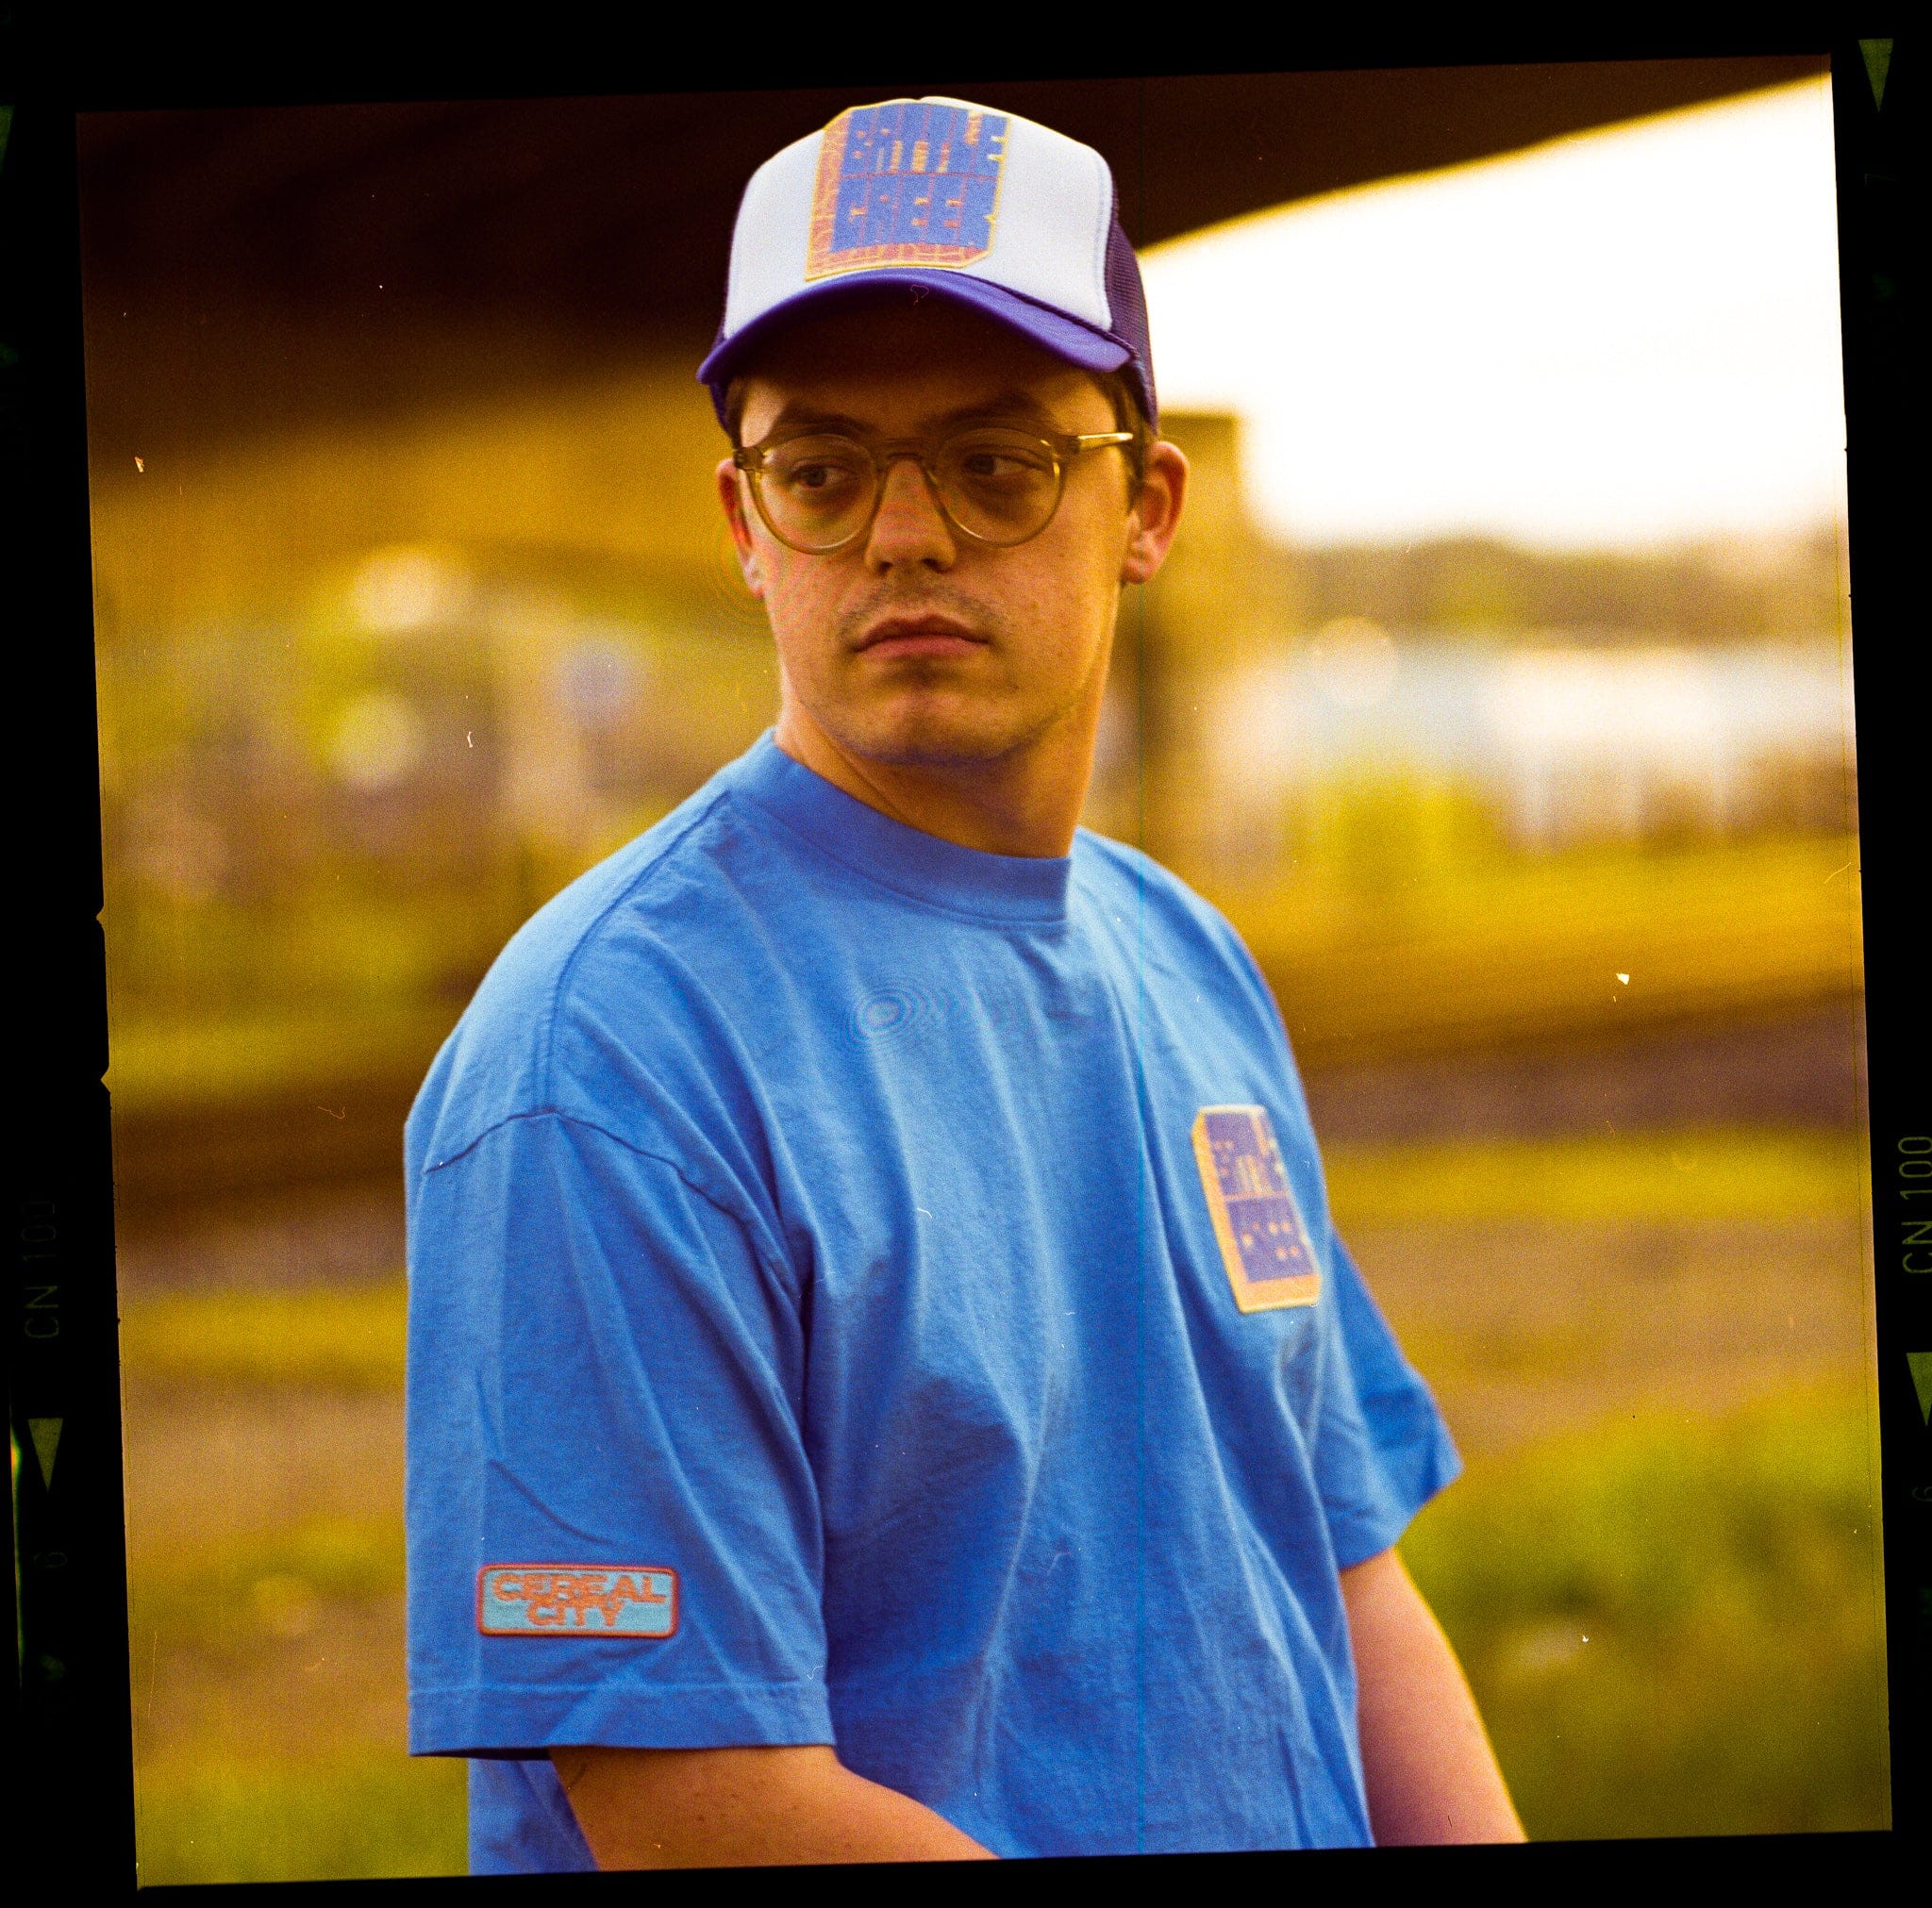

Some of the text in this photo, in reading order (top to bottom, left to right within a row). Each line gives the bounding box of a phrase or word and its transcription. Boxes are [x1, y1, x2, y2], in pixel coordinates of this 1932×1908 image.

[1896, 1135, 1932, 1274] CN 100
[20, 1200, 59, 1339] CN 100
[493, 1572, 668, 1605] CEREAL
[525, 1598, 625, 1627] CITY
